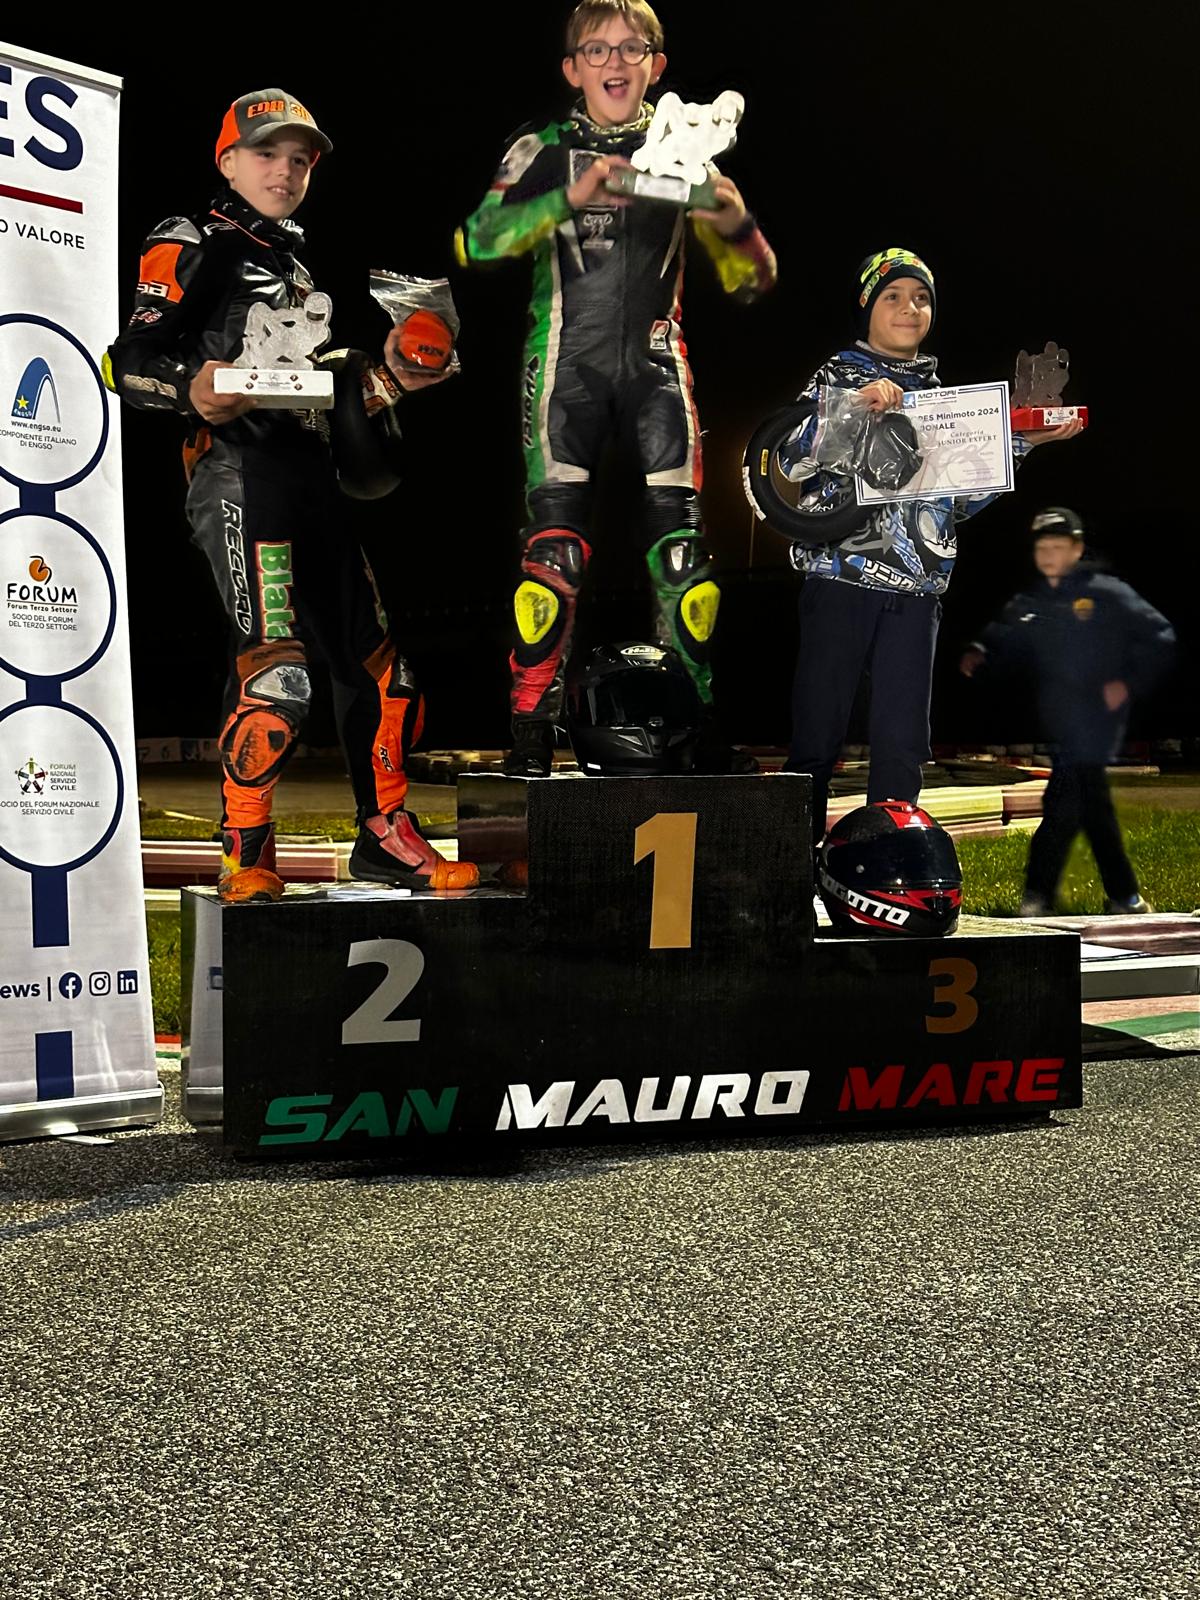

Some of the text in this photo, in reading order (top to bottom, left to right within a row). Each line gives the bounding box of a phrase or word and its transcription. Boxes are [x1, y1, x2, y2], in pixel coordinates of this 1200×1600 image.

[15, 222, 85, 250] VALORE
[936, 409, 976, 422] Minimoto
[977, 407, 1000, 415] 2024
[11, 420, 62, 433] www.engso.eu
[0, 429, 77, 446] OMPONENTE ITALIANO
[28, 441, 53, 450] ENGSO
[938, 438, 967, 448] JUNIOR
[221, 498, 253, 635] RECORD
[863, 558, 917, 591] ソニック
[7, 583, 78, 603] FORUM
[7, 602, 78, 614] Forum Terzo Settore
[12, 613, 33, 621] SOCIO
[33, 614, 47, 622] DEL
[23, 621, 45, 629] TERZO
[45, 623, 78, 631] SETTORE
[21, 808, 75, 816] SERVIZIO CIVILE
[634, 812, 698, 949] 1
[341, 938, 425, 1045] 2
[925, 957, 979, 1034] 3
[258, 1058, 1065, 1146] SAN MAURO MARE
